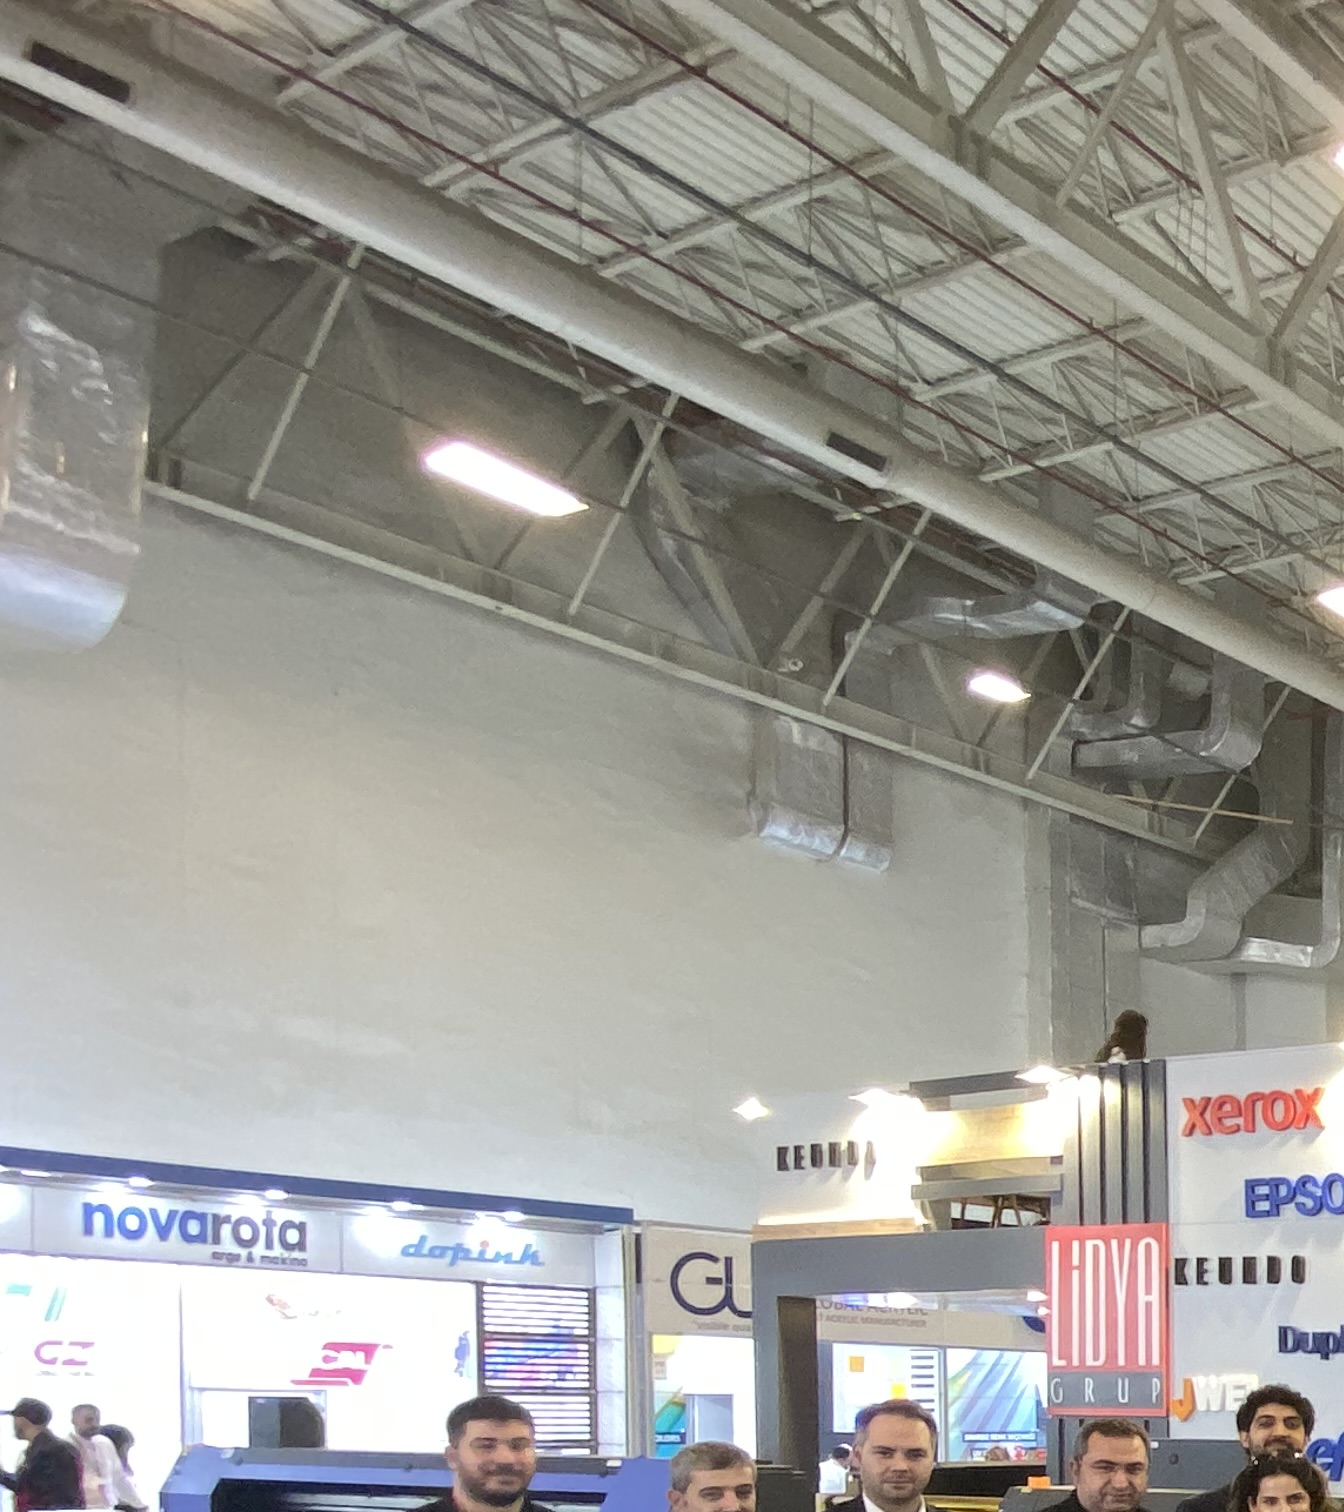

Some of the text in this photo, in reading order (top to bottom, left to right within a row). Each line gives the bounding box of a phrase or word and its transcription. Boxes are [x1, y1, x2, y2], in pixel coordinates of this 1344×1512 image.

[1181, 1087, 1326, 1137] xerox
[82, 1202, 308, 1252] novarota
[400, 1235, 546, 1267] dopink
[1174, 1255, 1307, 1285] KEUNDO
[1050, 1377, 1161, 1404] GRUP
[1172, 1373, 1259, 1422] JWE
